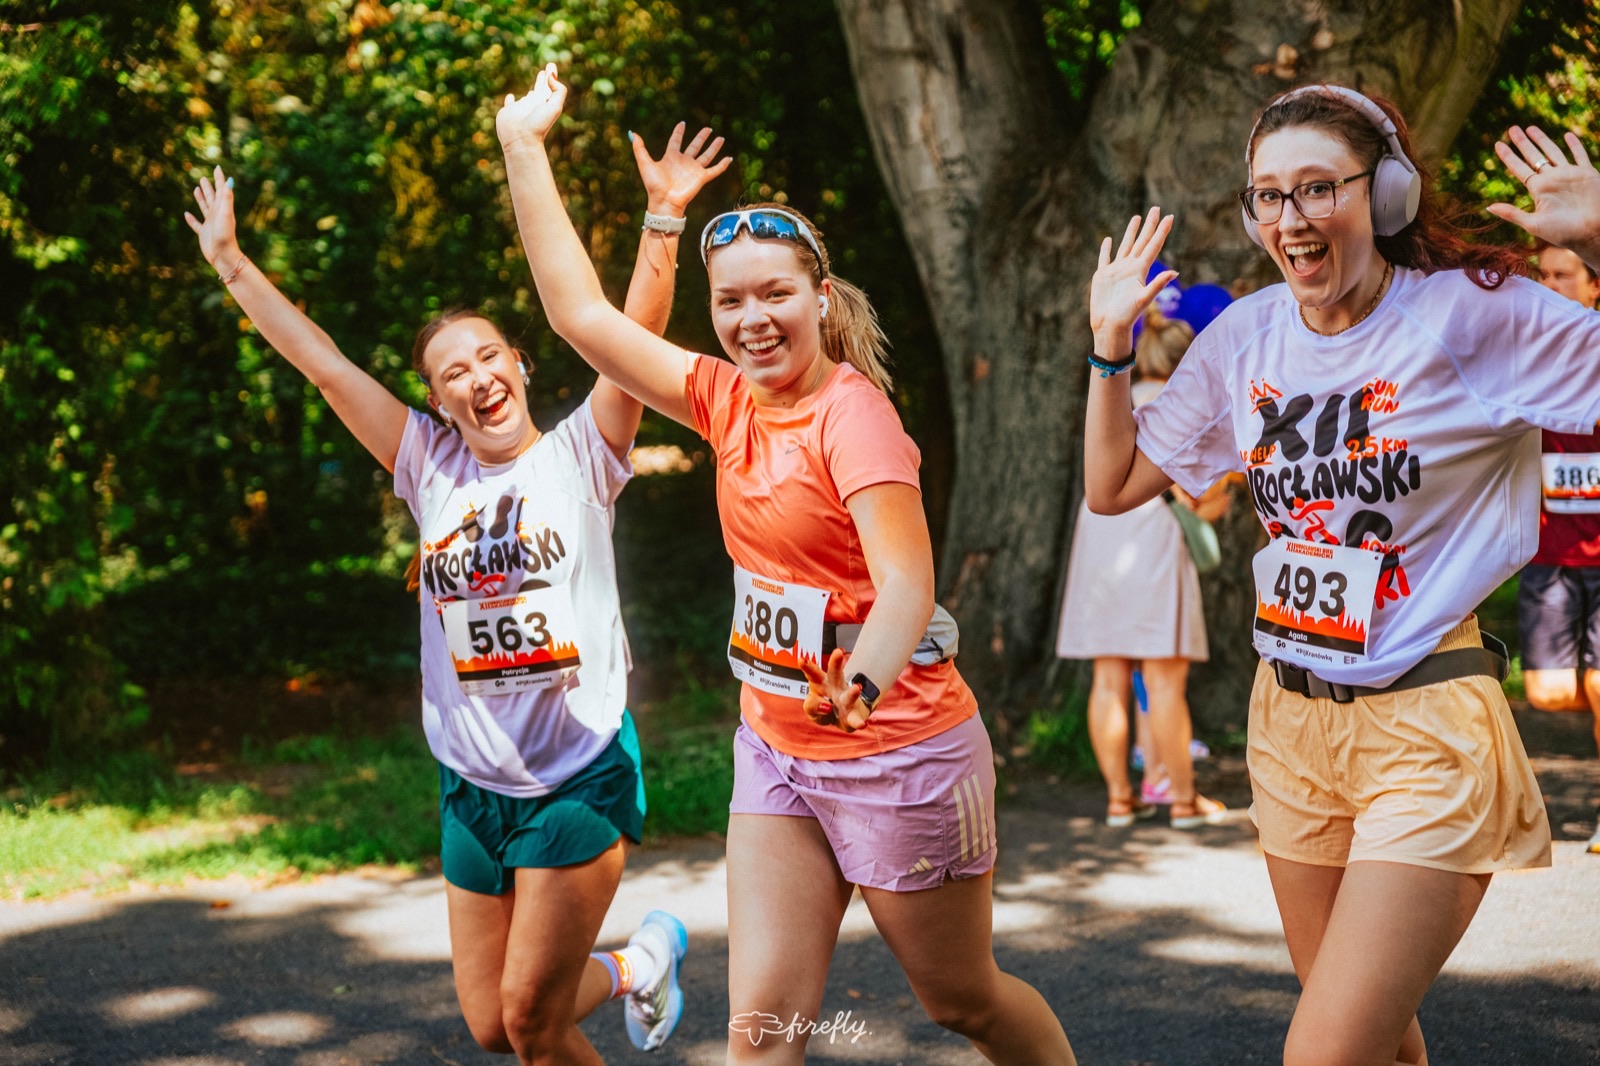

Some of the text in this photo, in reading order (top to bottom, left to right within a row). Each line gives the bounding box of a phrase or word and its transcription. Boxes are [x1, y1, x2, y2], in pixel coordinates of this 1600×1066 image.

[1362, 377, 1399, 398] FUN
[1361, 393, 1400, 414] RUN
[1253, 384, 1373, 462] XII
[1250, 444, 1277, 461] HELP
[1382, 437, 1408, 455] KM
[1274, 563, 1348, 617] 493
[744, 594, 798, 649] 380
[467, 612, 551, 655] 563
[1288, 630, 1308, 642] Agata
[1276, 639, 1286, 648] Go
[1343, 655, 1358, 665] EF
[501, 667, 529, 677] Patrycja
